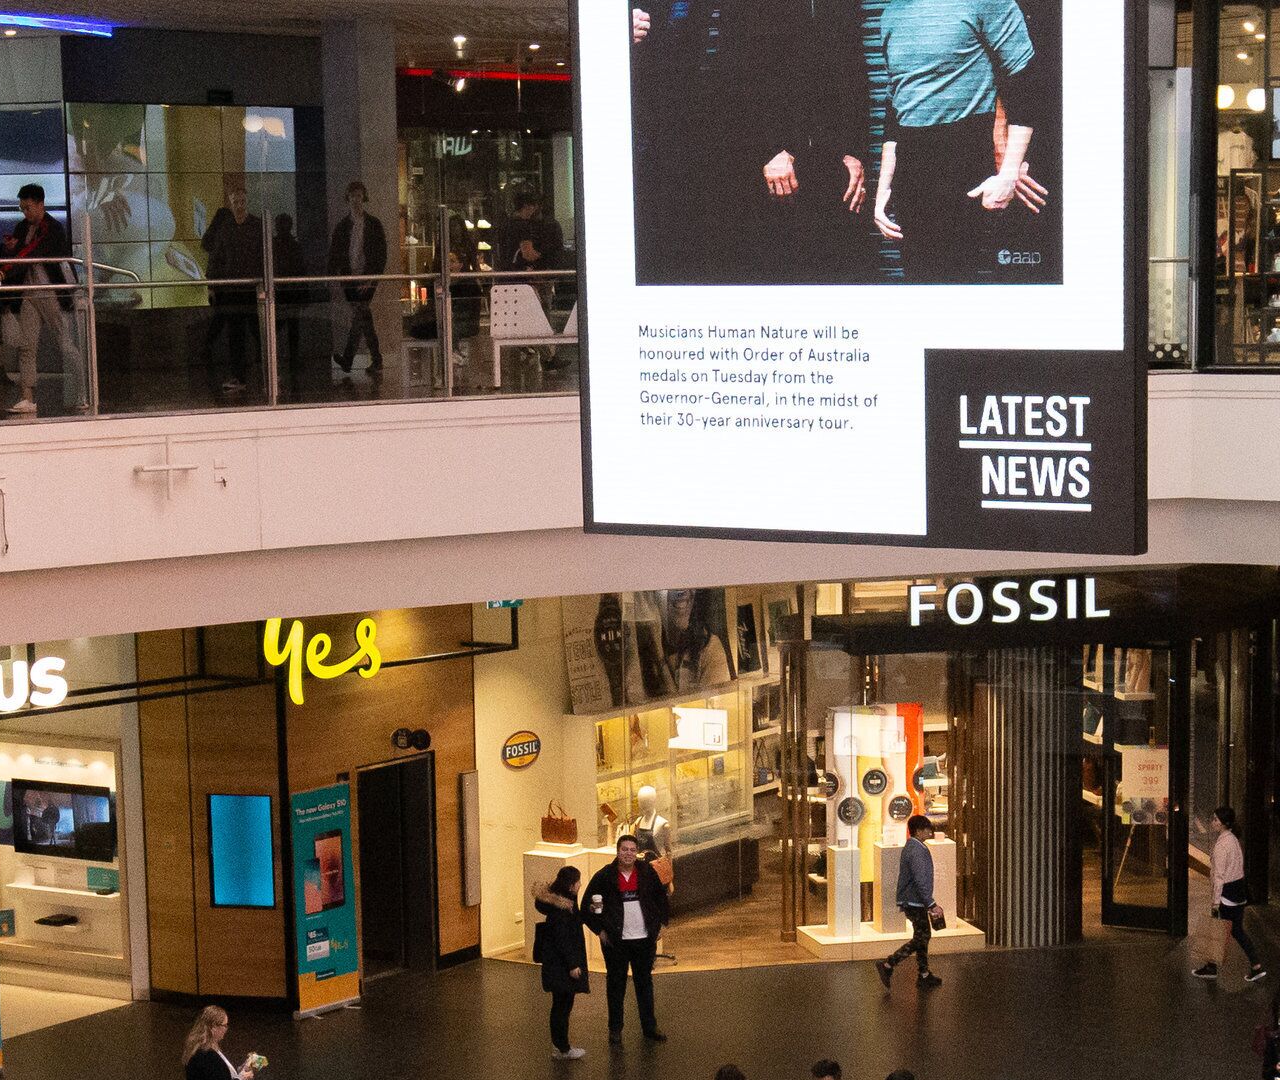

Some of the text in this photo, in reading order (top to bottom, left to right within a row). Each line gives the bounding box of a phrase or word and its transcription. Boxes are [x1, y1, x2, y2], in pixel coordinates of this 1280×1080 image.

[638, 325, 859, 339] Musicians Human Nature will be
[639, 347, 870, 362] honoured with Order of Australia
[639, 369, 833, 386] medals on Tuesday from the
[639, 391, 878, 407] Governor-General, in the midst of
[640, 411, 853, 431] their 30-year anniversary tour.
[959, 394, 1091, 437] LATEST
[981, 455, 1091, 498] NEWS
[909, 577, 1111, 627] FOSSIL
[264, 618, 382, 704] yes
[506, 741, 538, 758] FOSSIL
